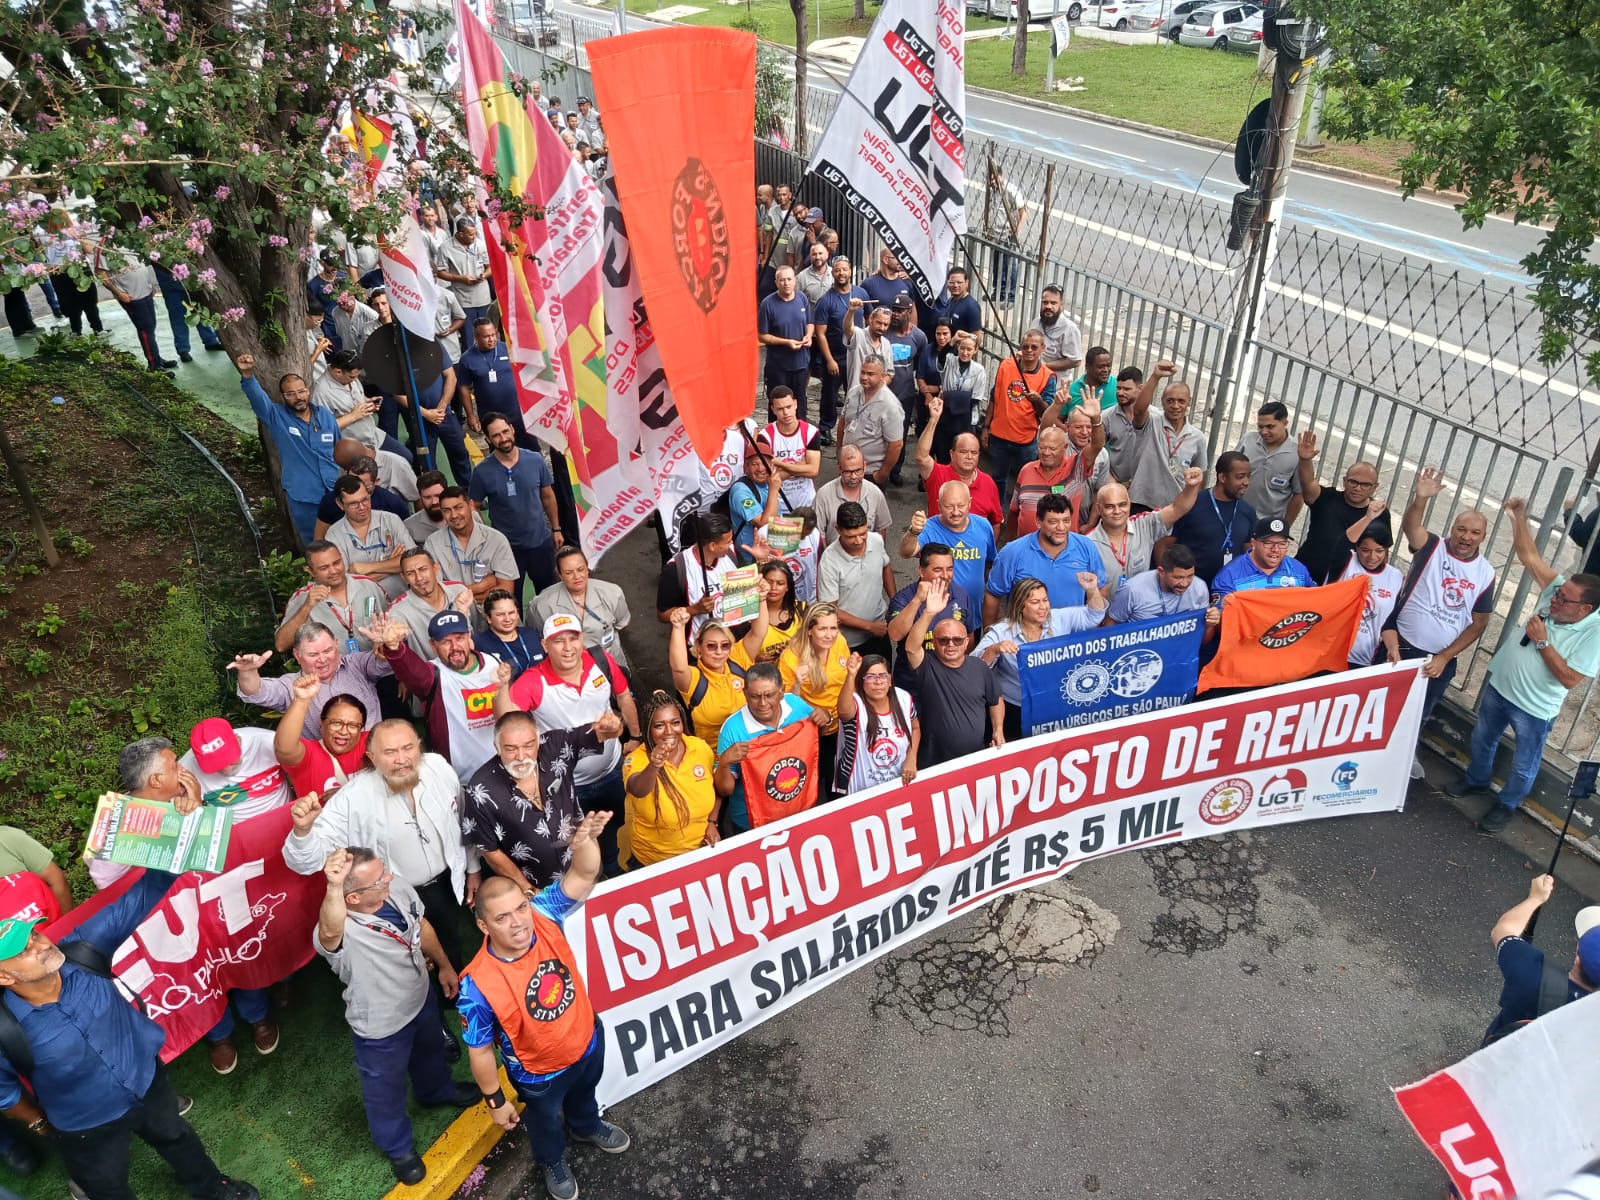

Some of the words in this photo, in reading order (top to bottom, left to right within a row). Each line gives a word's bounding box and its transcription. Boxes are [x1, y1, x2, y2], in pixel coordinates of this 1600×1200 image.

[893, 40, 916, 65] UGT
[904, 29, 928, 57] UGT
[824, 167, 848, 188] UGT
[860, 202, 881, 225] UGT
[880, 226, 901, 251] UGT
[898, 251, 919, 275] UGT
[917, 277, 933, 304] UGT
[950, 547, 981, 561] RASIL
[437, 615, 459, 626] CTB
[1027, 644, 1083, 668] SINDICATO
[1086, 638, 1107, 655] DOS
[1109, 618, 1198, 650] TRABALHADORES
[468, 691, 496, 712] CT
[1031, 707, 1113, 736] METALÚRGICOS
[1115, 704, 1129, 717] DE
[1132, 699, 1153, 716] SÃO
[770, 758, 800, 776] FORÇA
[767, 775, 806, 801] SINDICAL
[1258, 789, 1306, 808] UGT
[592, 830, 840, 992] ISENÇÃO
[850, 802, 923, 888] DE
[931, 735, 1149, 857] IMPOSTO
[1161, 718, 1227, 780] DE
[1234, 686, 1389, 765] RENDA
[614, 978, 743, 1077] PARA
[750, 884, 941, 1010] SALÁRIOS
[948, 836, 1010, 906] ATÉ
[1023, 830, 1069, 874] R$
[1079, 814, 1106, 854] 5
[1118, 796, 1183, 845] MIL
[146, 984, 191, 1020] ÃO
[194, 937, 261, 990] PAULO
[534, 974, 575, 1020] SINDICAL
